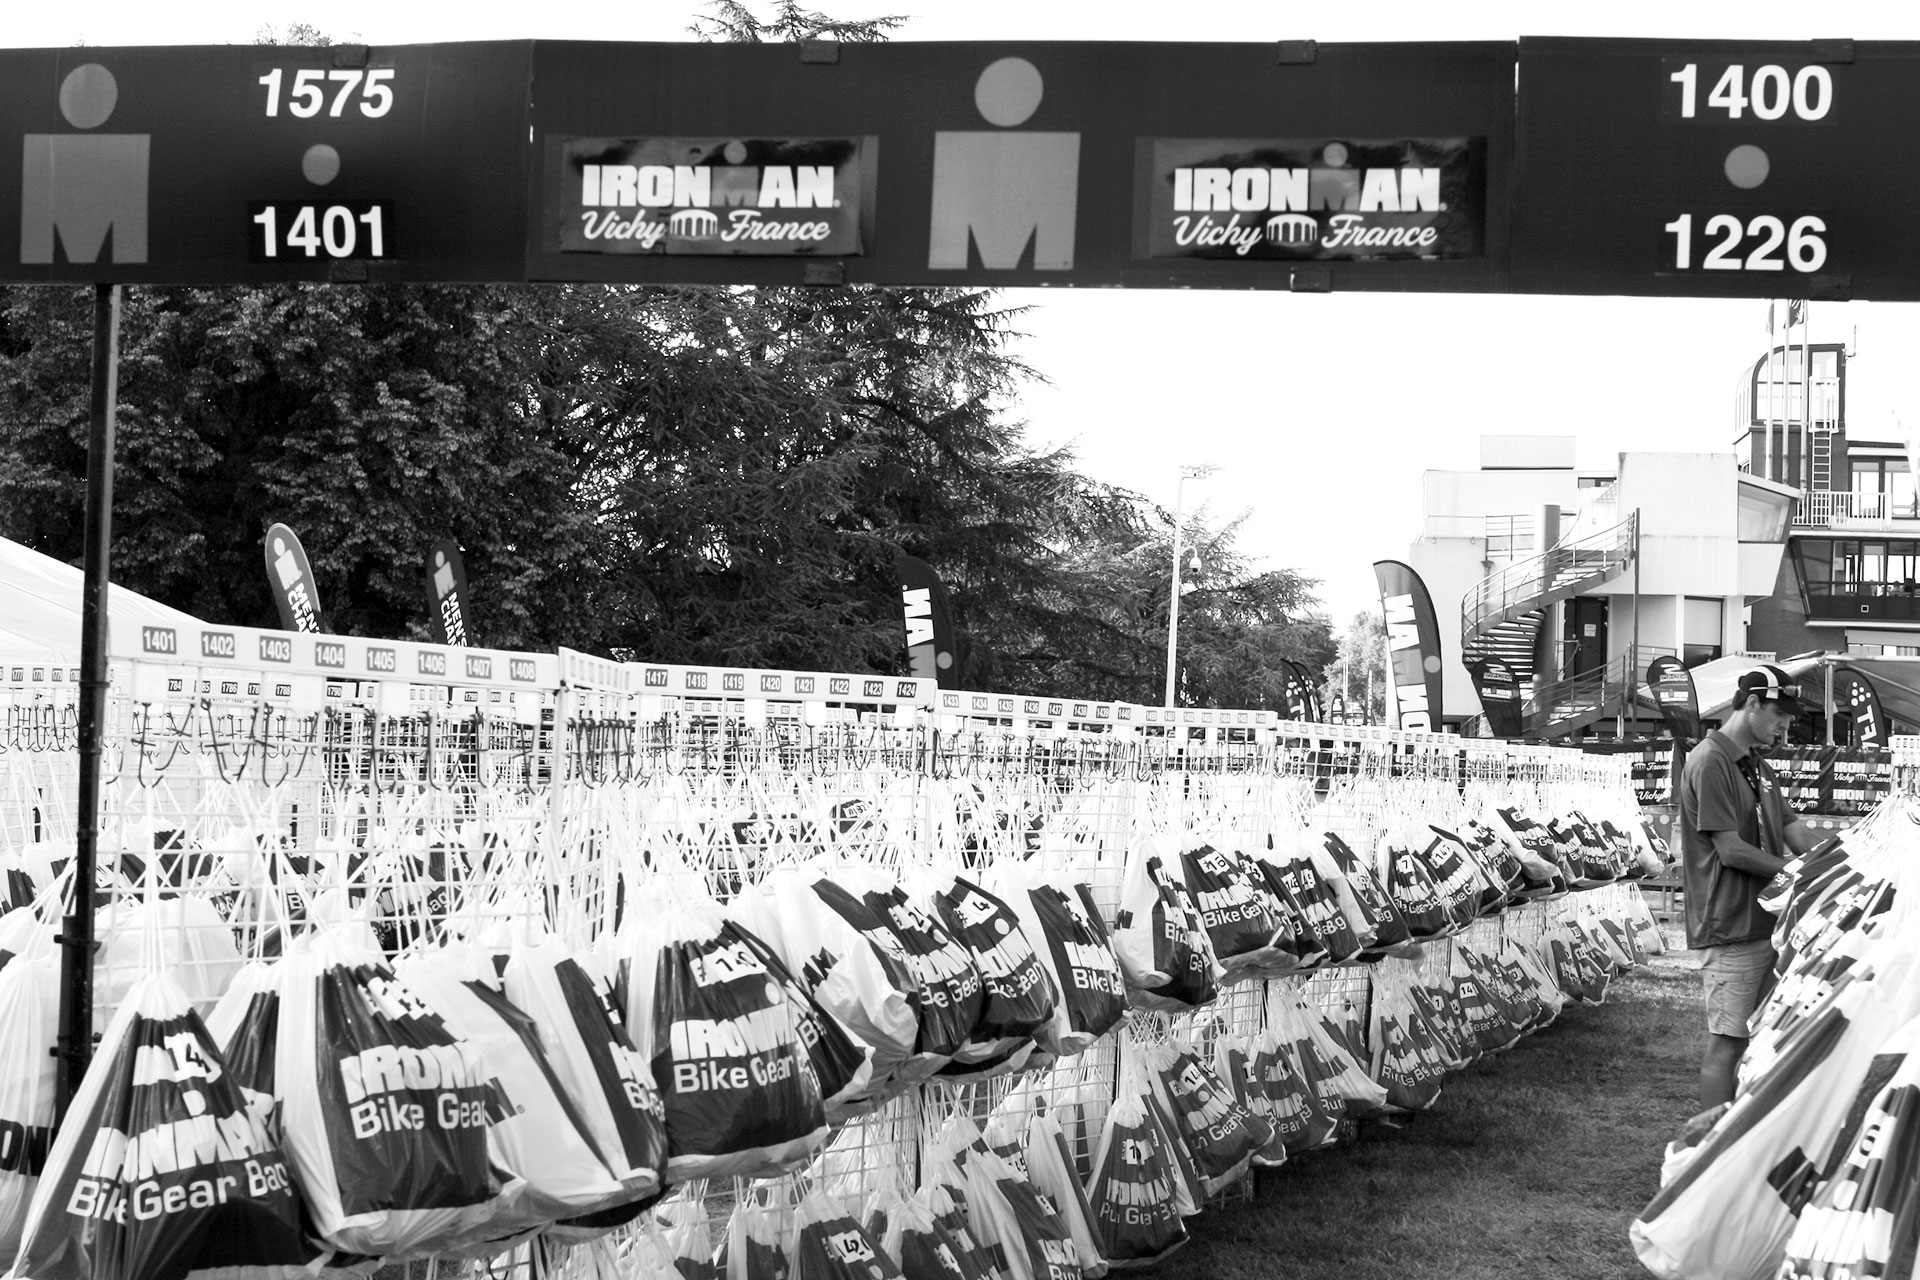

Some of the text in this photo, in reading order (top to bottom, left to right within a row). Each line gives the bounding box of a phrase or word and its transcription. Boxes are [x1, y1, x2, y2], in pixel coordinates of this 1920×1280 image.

[258, 68, 395, 118] 1575
[1670, 63, 1833, 121] 1400
[582, 164, 838, 208] IRONMAN
[1173, 168, 1446, 212] IRONMAN
[254, 206, 384, 257] 1401
[582, 209, 831, 248] Vichy France
[1173, 215, 1438, 255] Vichy France
[1665, 215, 1828, 272] 1226
[143, 630, 535, 681] 1401 1402 1403 1404 1405 1406 1407 1408
[646, 670, 667, 686] 1417
[686, 674, 707, 688] 1418
[723, 676, 744, 690] 1419
[1203, 908, 1241, 929] Bike
[673, 1055, 795, 1094] Bike Gear
[350, 1095, 425, 1139] Bike
[133, 1174, 237, 1221] Gear
[245, 1158, 293, 1198] Bag
